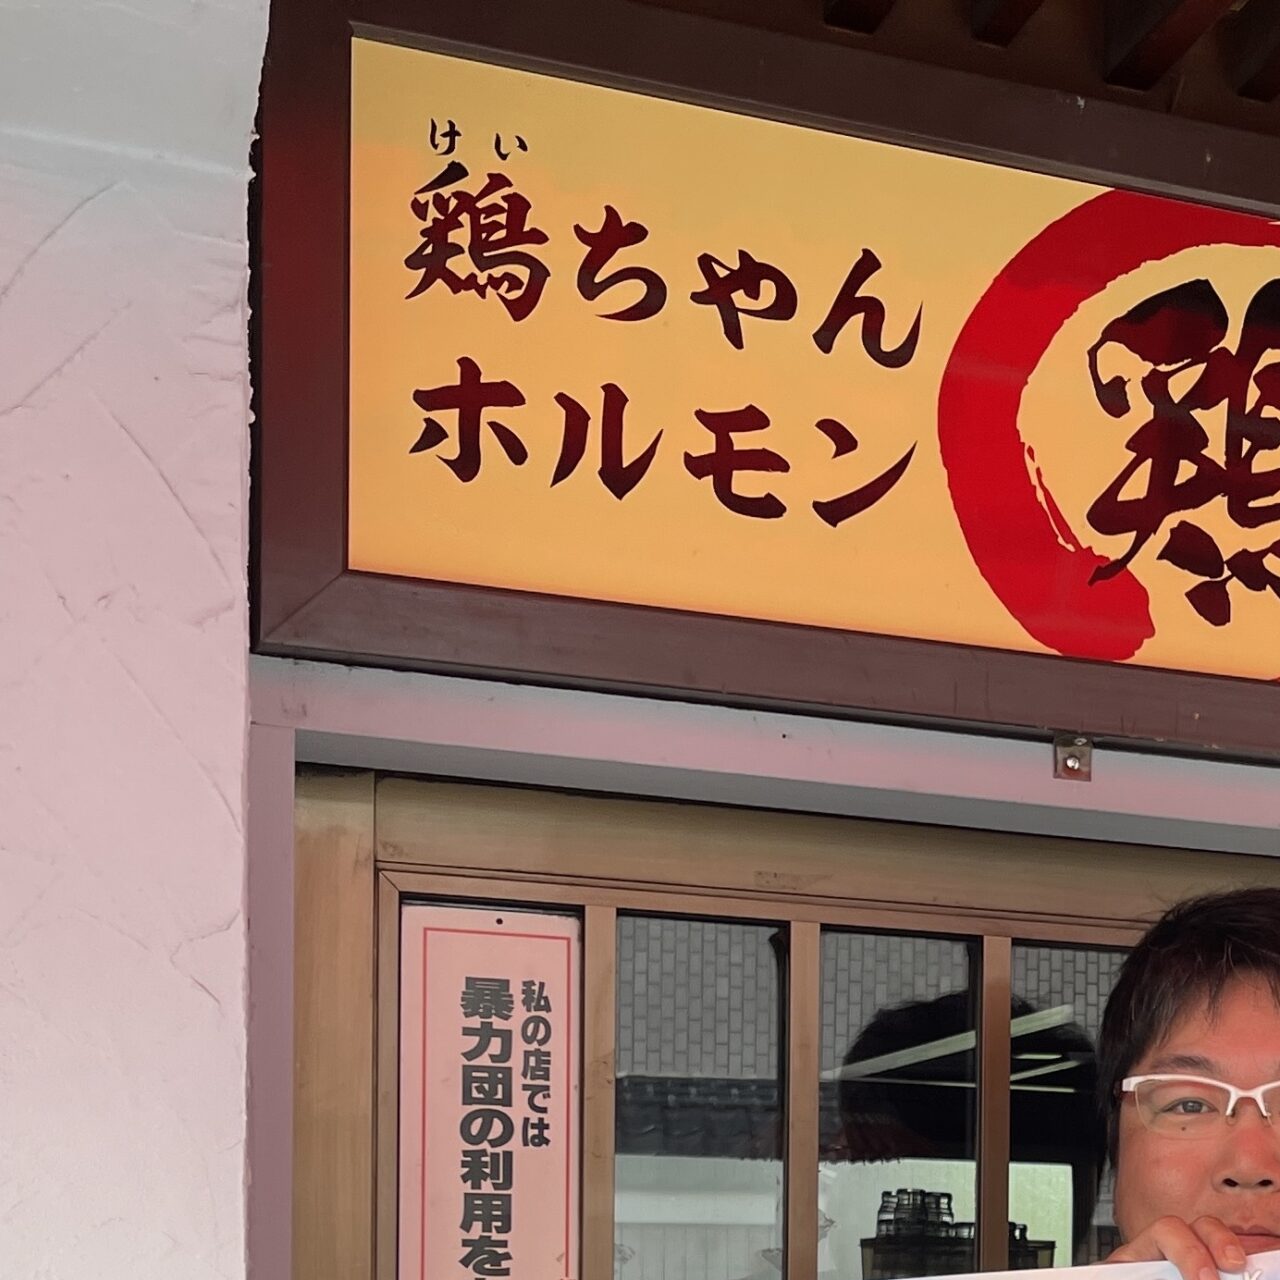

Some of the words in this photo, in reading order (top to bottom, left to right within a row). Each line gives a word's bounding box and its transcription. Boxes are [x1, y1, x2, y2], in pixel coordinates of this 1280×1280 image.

[428, 119, 529, 161] けい
[403, 161, 924, 370] 鶏ちゃん
[409, 356, 919, 529] ホルモン
[521, 980, 552, 1147] 私の店では
